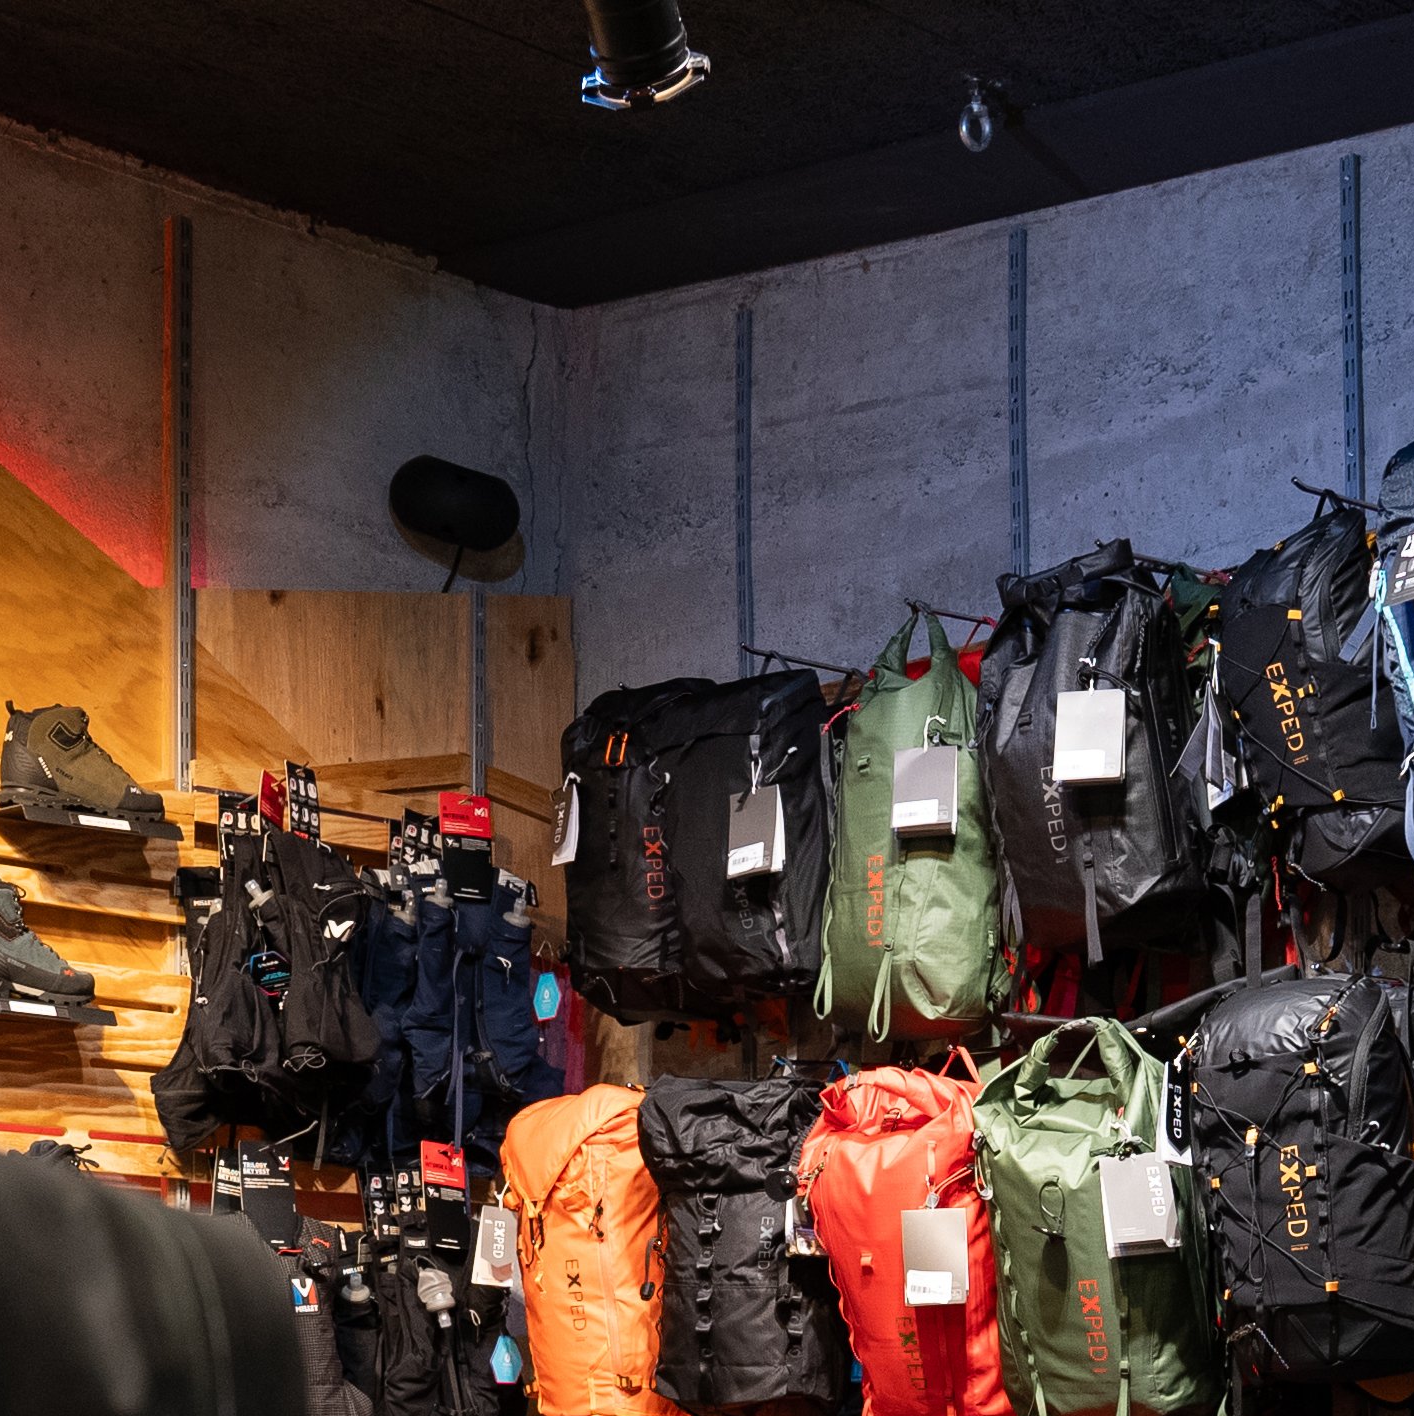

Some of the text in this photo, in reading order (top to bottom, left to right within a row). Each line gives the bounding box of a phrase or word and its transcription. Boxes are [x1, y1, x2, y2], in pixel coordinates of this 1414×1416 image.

[1266, 661, 1305, 753] EXPED
[38, 756, 53, 779] MILLET
[554, 801, 566, 844] EXPED
[1040, 765, 1069, 853] EXPED
[643, 826, 666, 900] EXPED
[867, 854, 884, 934] EXPED
[1173, 1084, 1183, 1139] EXPED
[1145, 1165, 1167, 1217] EXPED
[1279, 1144, 1309, 1239] EXPED
[342, 1265, 365, 1275] MILLET
[492, 1217, 506, 1260] EXPED
[758, 1215, 776, 1271] EXPED
[294, 1304, 319, 1313] MILLET
[564, 1258, 587, 1332] EXPED
[1078, 1278, 1109, 1362] EXPED
[895, 1316, 928, 1392] EXPED
